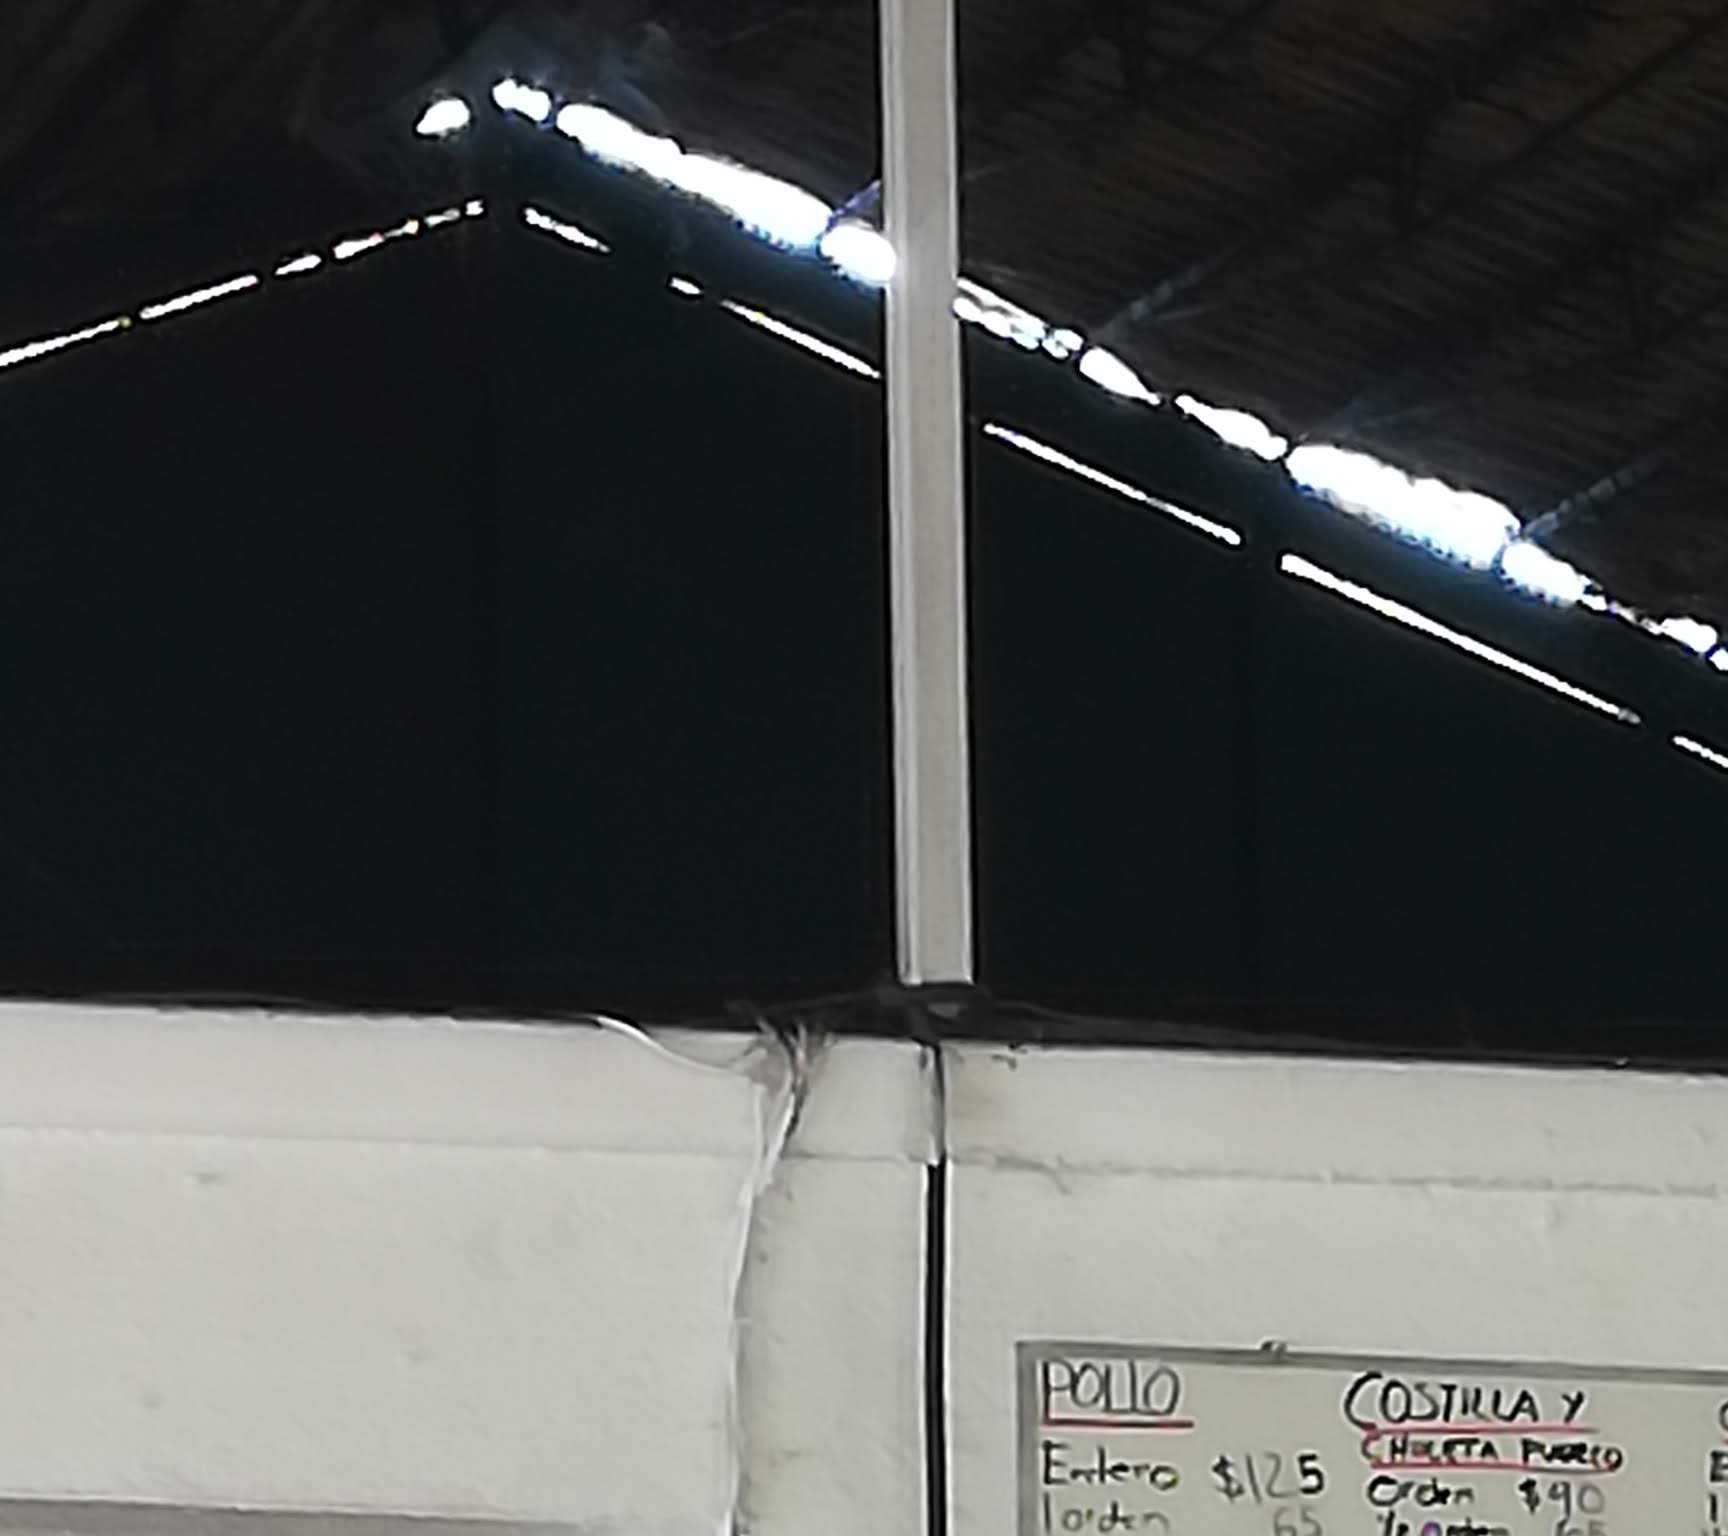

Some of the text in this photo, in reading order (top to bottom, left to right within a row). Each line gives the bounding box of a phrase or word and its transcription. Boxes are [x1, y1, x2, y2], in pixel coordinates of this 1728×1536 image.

[1043, 1358, 1181, 1418] POLLO
[1344, 1371, 1540, 1430] COSTILLA
[1043, 1440, 1179, 1490] Entero
